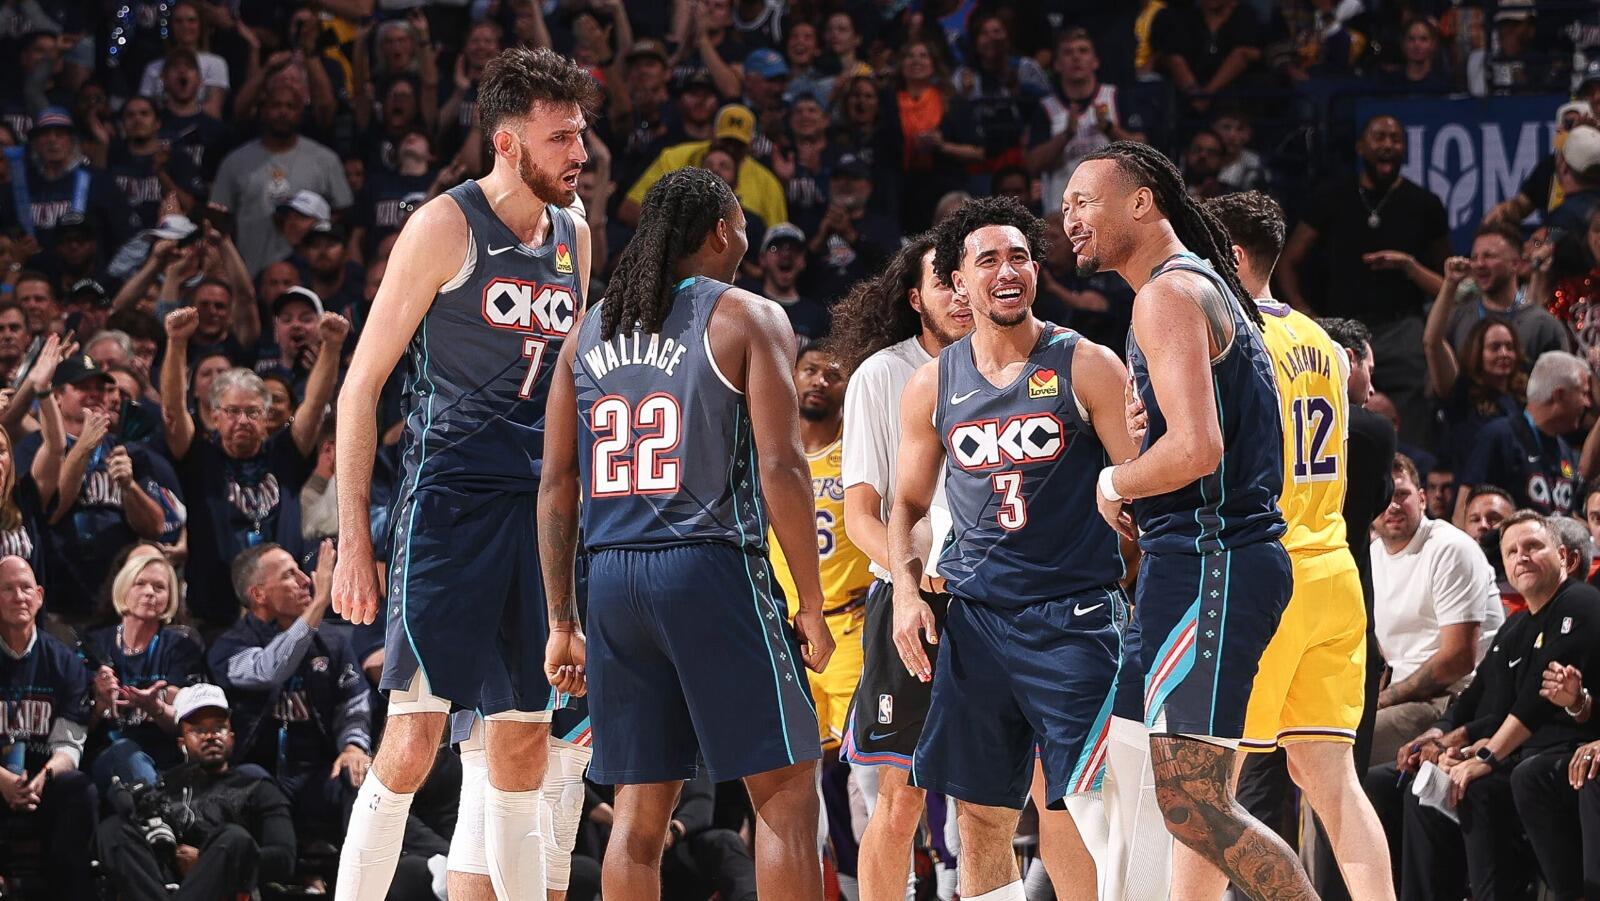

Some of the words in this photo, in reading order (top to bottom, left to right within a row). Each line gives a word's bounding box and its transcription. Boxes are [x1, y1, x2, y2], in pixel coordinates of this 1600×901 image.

[482, 279, 575, 336] OKC
[518, 338, 548, 398] 7
[584, 332, 687, 380] WALLACE
[591, 392, 681, 497] 22
[948, 413, 1064, 470] OKC
[1293, 396, 1337, 482] 12
[991, 471, 1027, 531] 3
